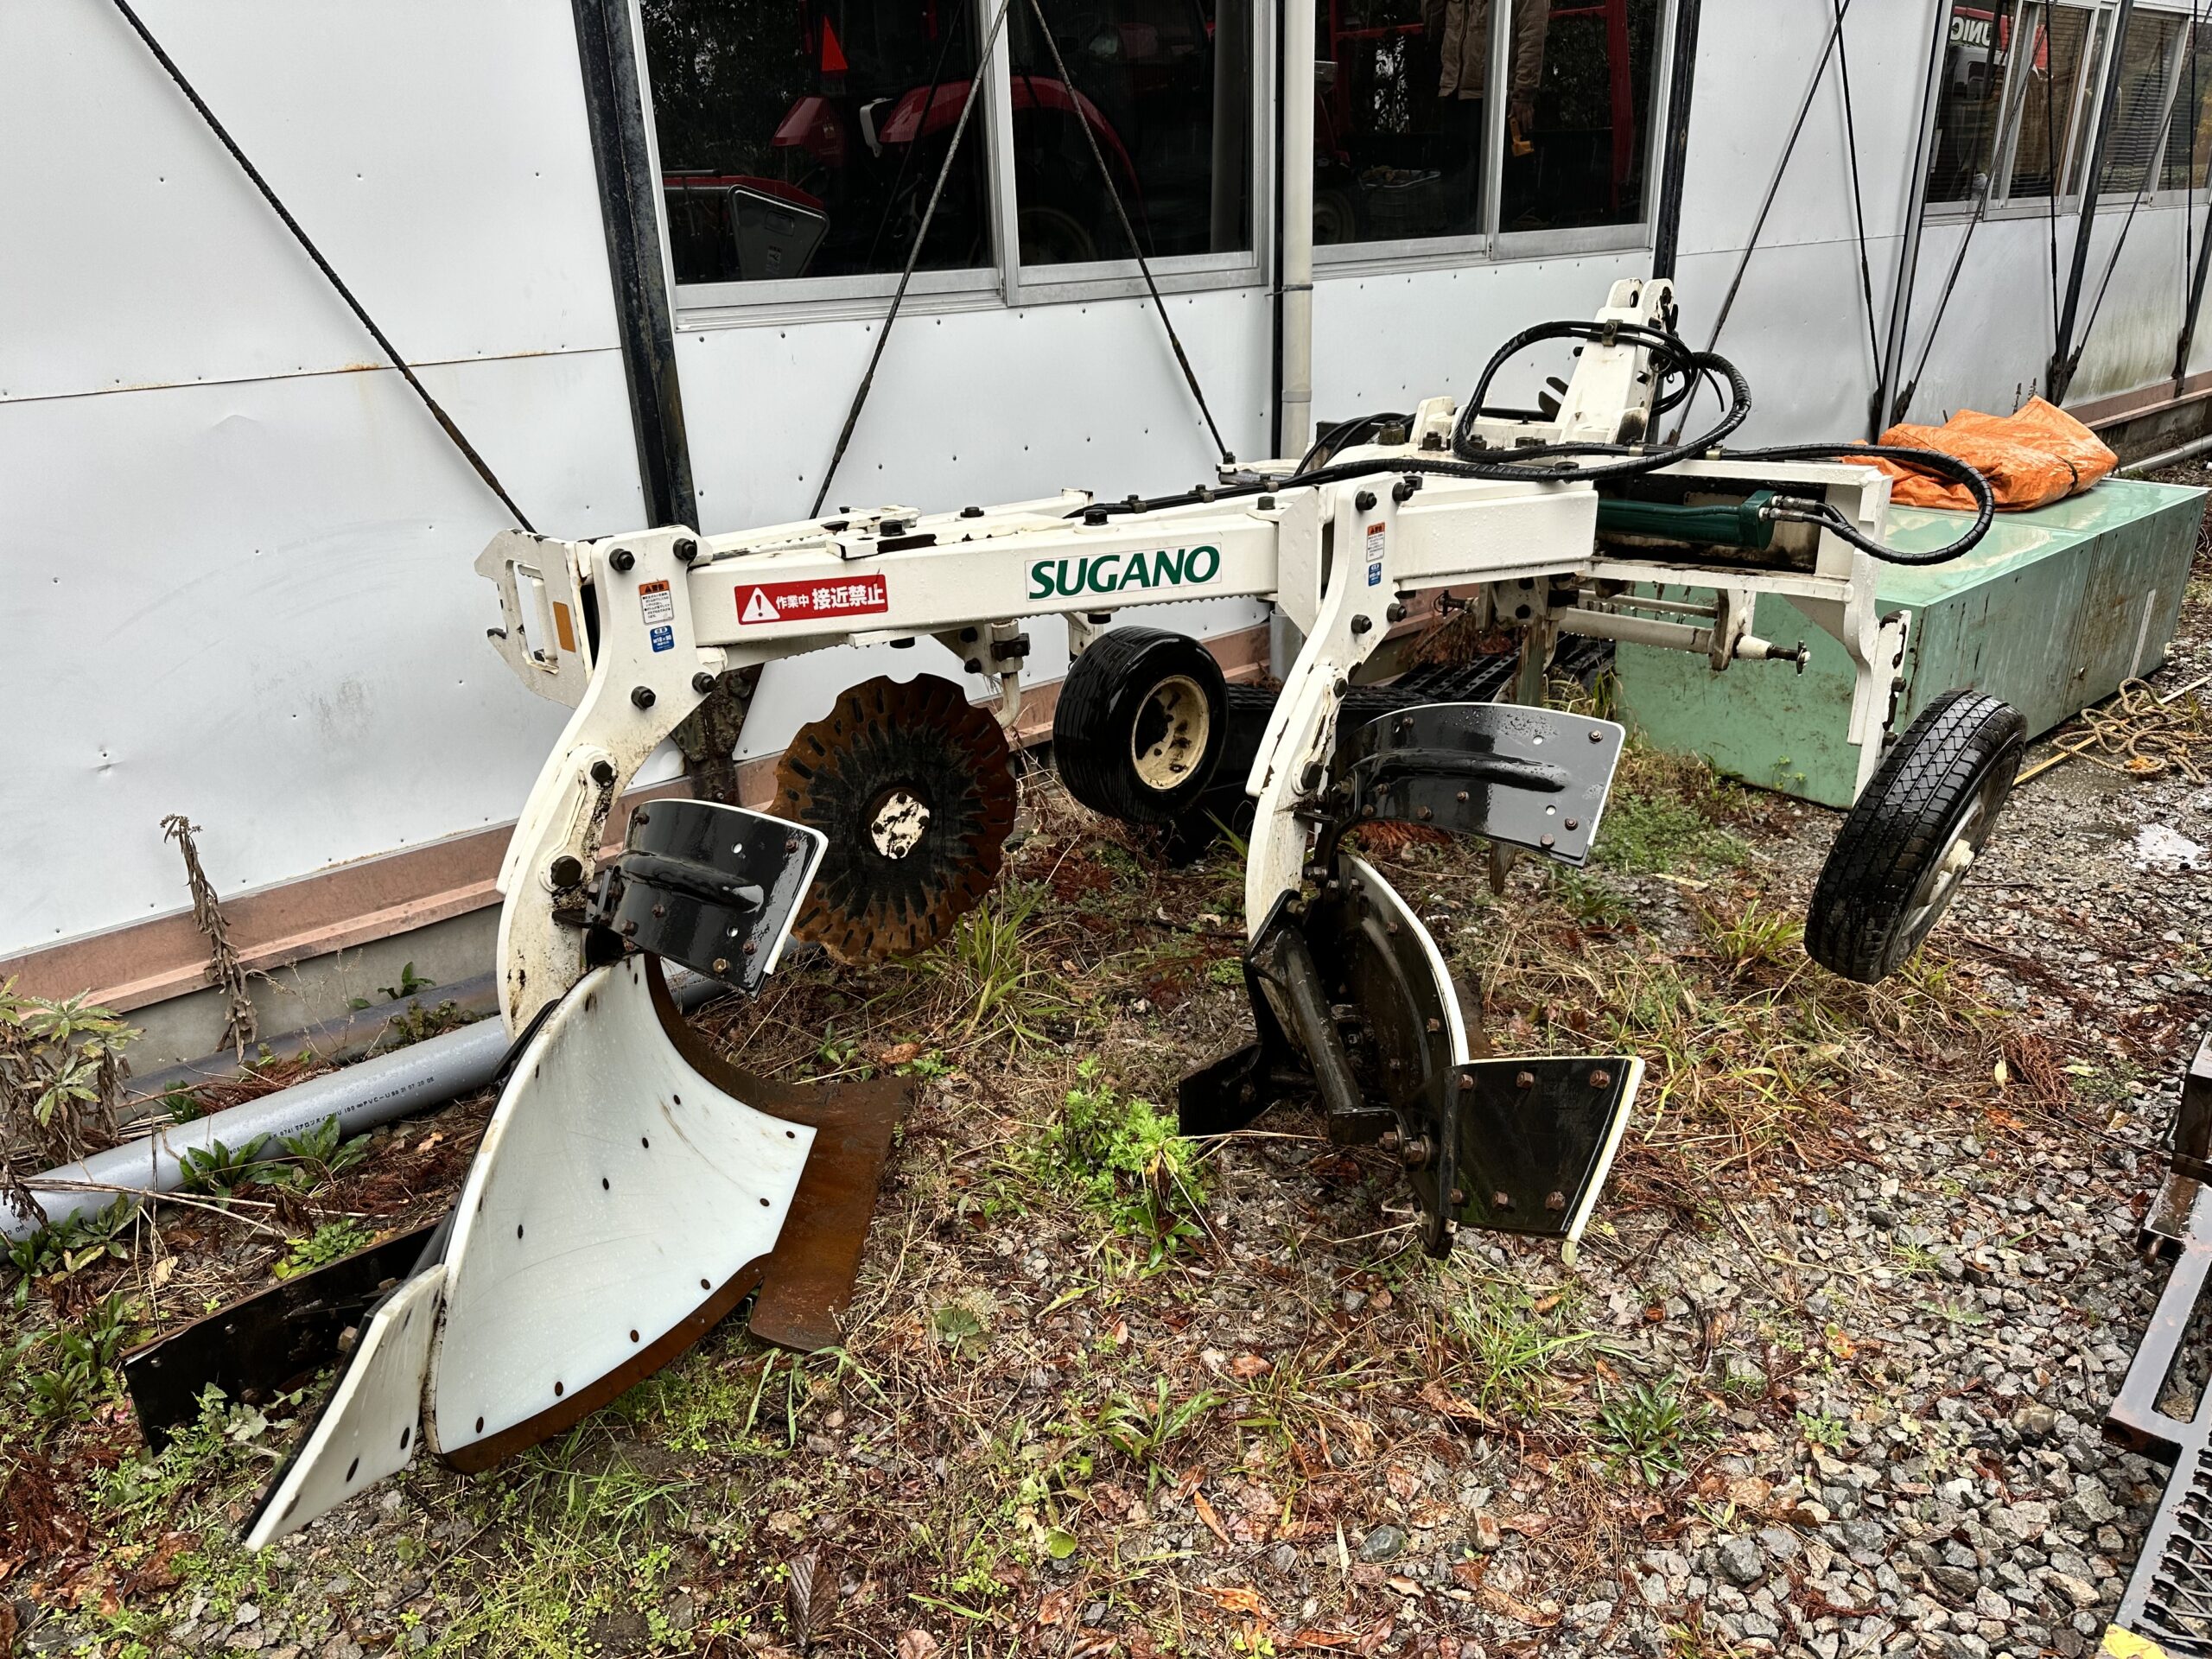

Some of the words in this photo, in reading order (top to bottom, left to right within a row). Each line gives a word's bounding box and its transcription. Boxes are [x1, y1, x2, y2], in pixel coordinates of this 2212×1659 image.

[1029, 545, 1220, 600] SUGANO
[776, 594, 810, 609] 作業中
[811, 583, 886, 610] 接近禁止
